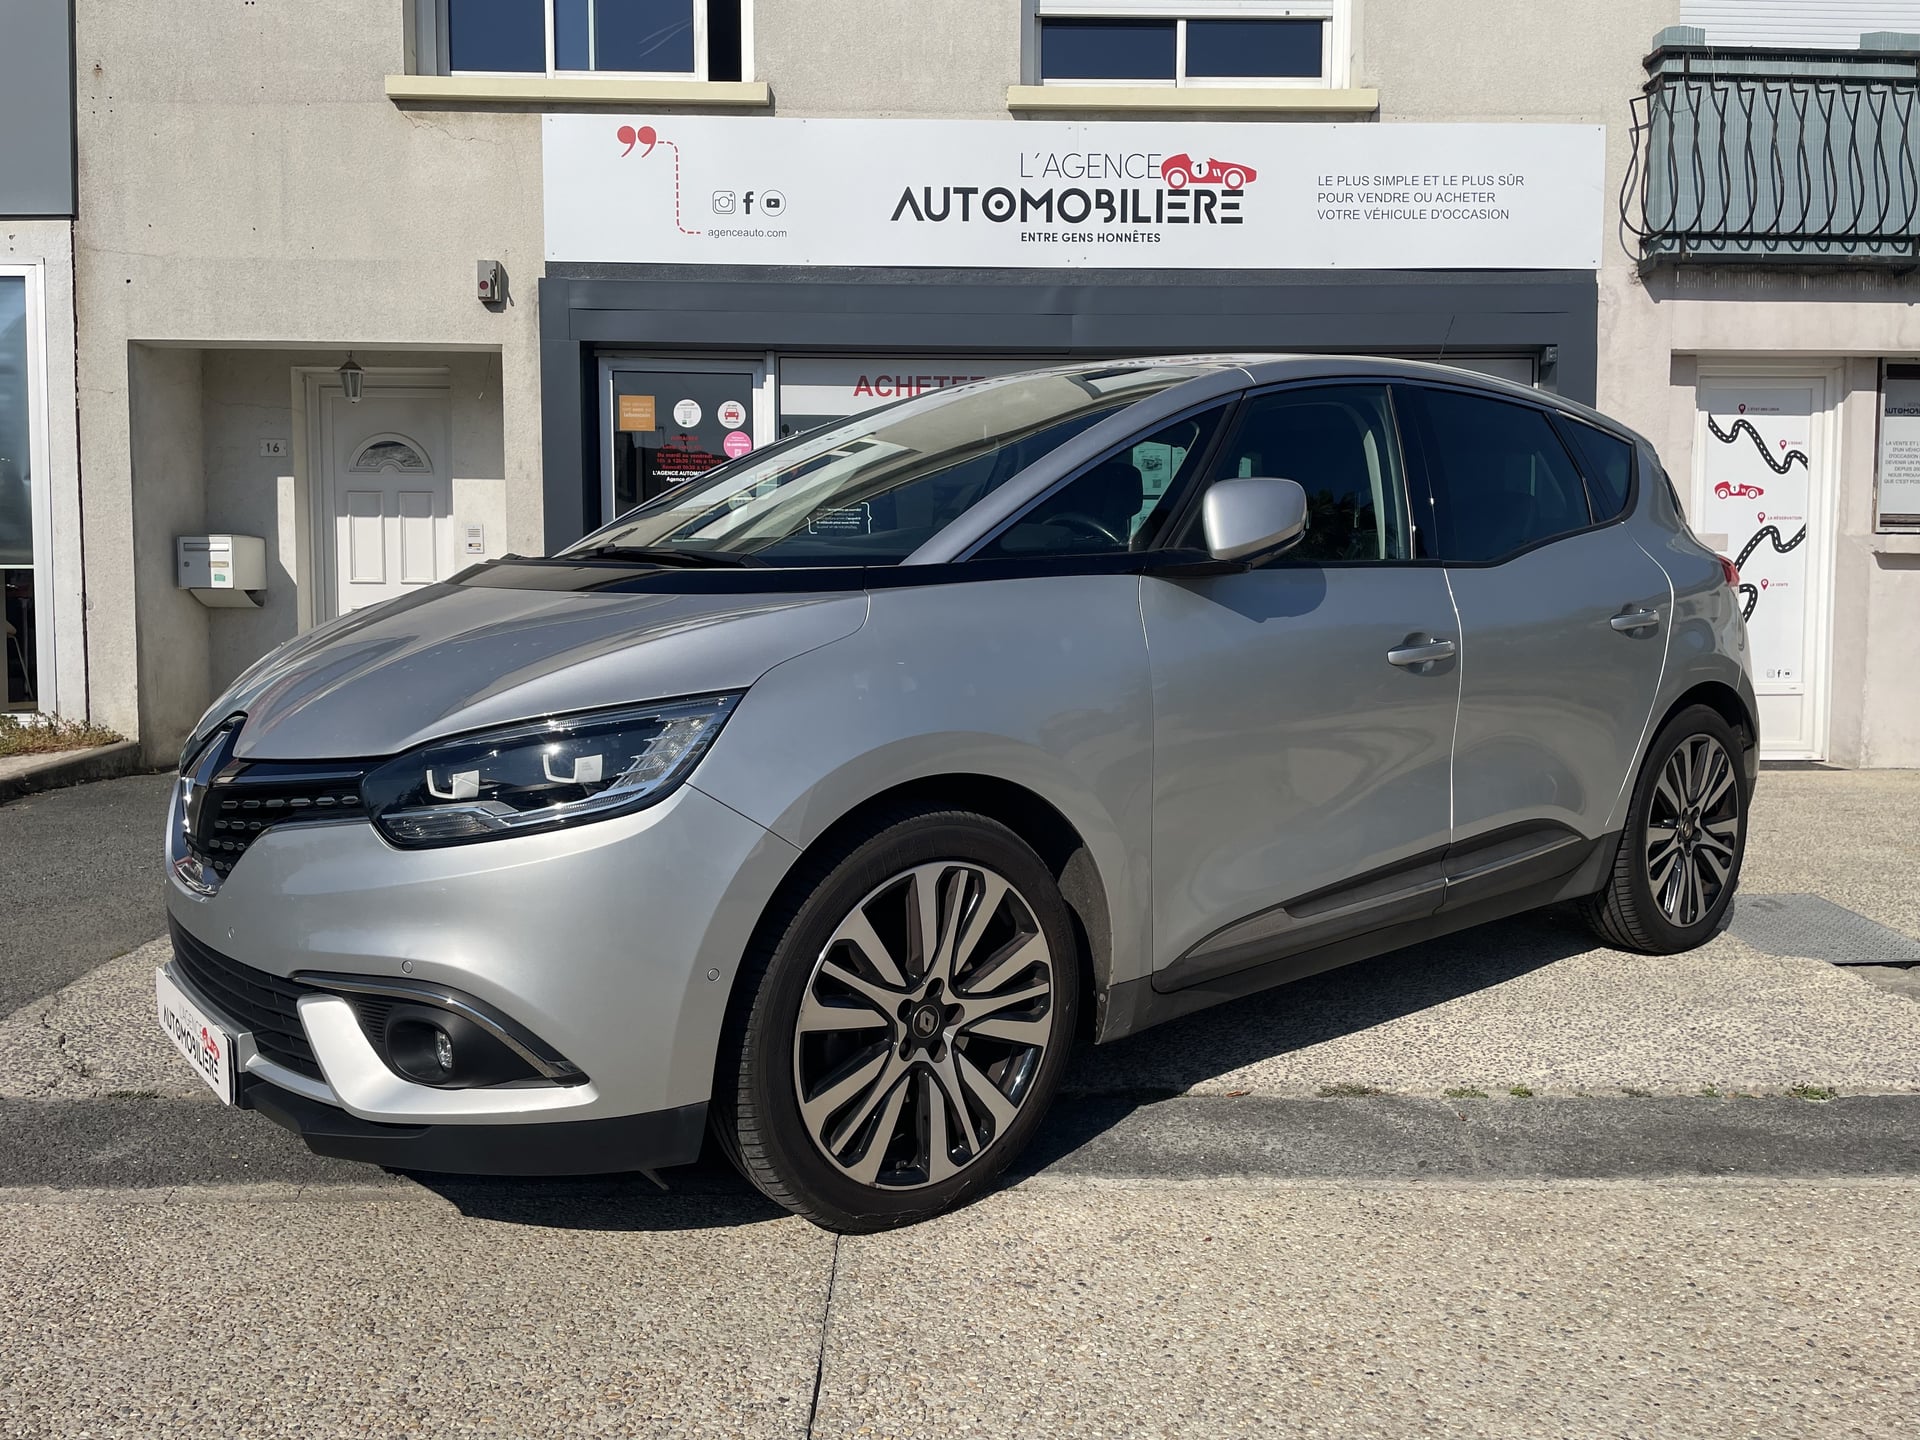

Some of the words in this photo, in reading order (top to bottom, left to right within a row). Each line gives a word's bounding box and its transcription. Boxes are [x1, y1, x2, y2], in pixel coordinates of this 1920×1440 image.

[1020, 152, 1162, 179] L'AGENCE
[1317, 175, 1333, 186] LE
[1336, 175, 1370, 186] PLUS
[1373, 175, 1420, 186] SIMPLE
[1423, 175, 1439, 186] ET
[1442, 175, 1458, 186] LE
[1461, 175, 1495, 186] PLUS
[1498, 173, 1525, 186] SÛR
[1317, 192, 1354, 203] POUR
[1357, 192, 1410, 203] VENDRE
[1413, 192, 1433, 203] OU
[1435, 192, 1496, 203] ACHETER
[1317, 209, 1361, 220] VOTRE
[1364, 206, 1427, 220] VÉHICULE
[1430, 208, 1510, 220] D'OCCASION
[707, 229, 788, 239] agenceauto.com
[1020, 232, 1059, 242] ENTRE
[1061, 232, 1094, 243] GENS
[1097, 230, 1161, 243] HONNÊTES
[853, 375, 986, 398] ACHET
[266, 442, 280, 453] 16
